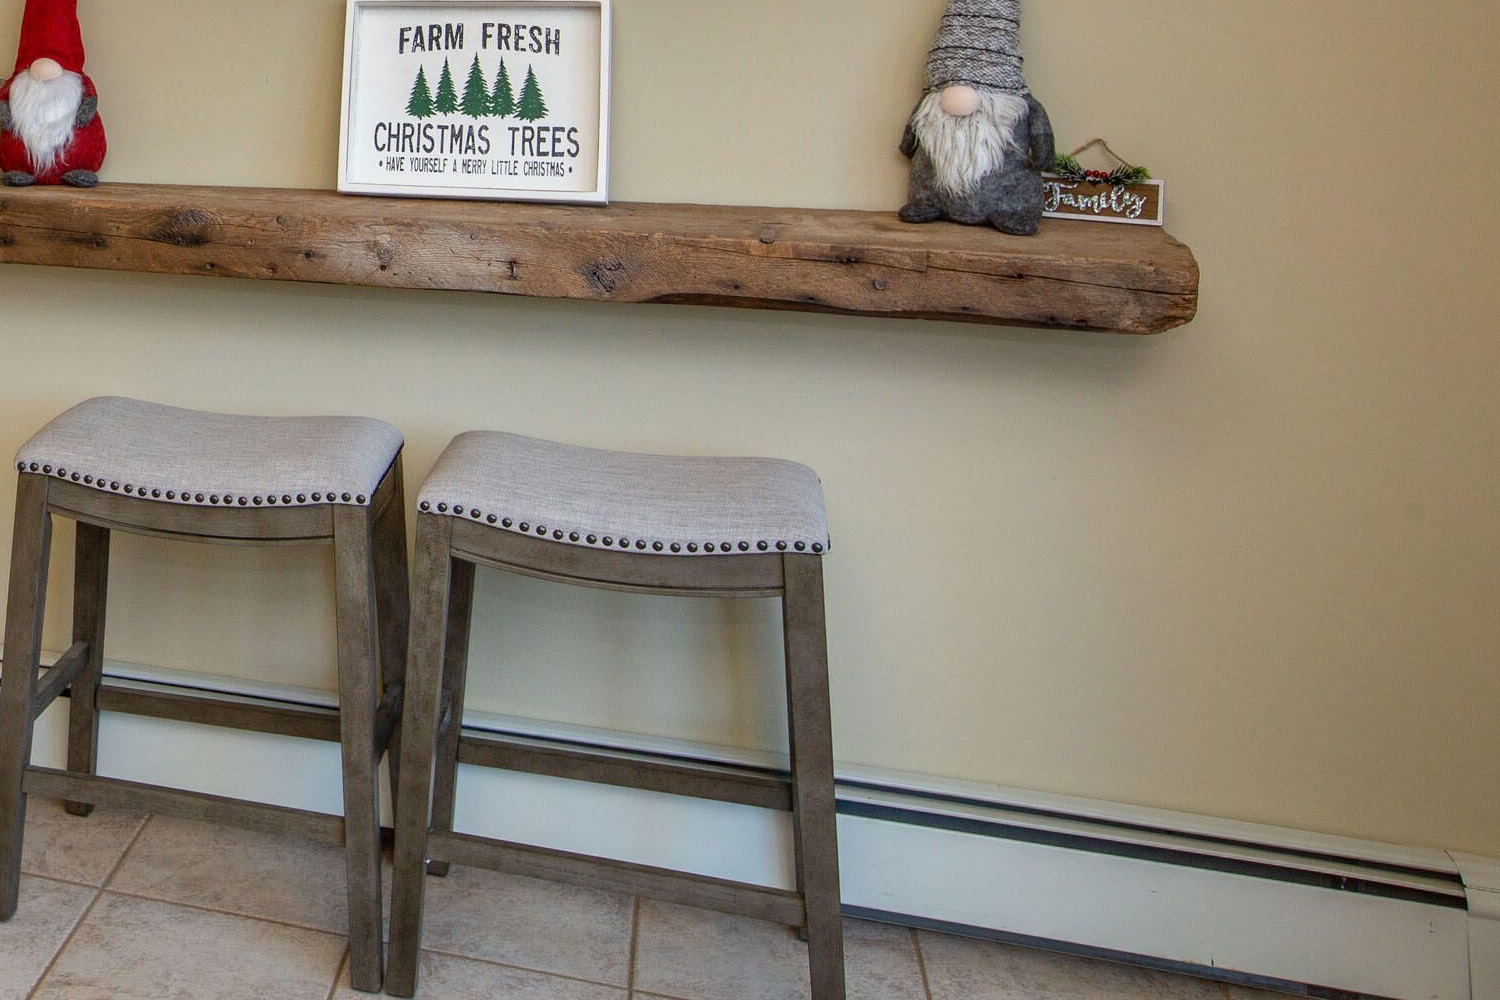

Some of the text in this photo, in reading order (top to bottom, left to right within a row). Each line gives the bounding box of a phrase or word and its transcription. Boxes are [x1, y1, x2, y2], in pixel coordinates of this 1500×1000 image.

[398, 22, 561, 56] FARM FRESH
[373, 121, 580, 158] CHRISTMAS TREES
[385, 156, 565, 177] HAVE YOURSELF A MERRY LITTLE CHRISTMAS
[1043, 181, 1147, 219] Family
